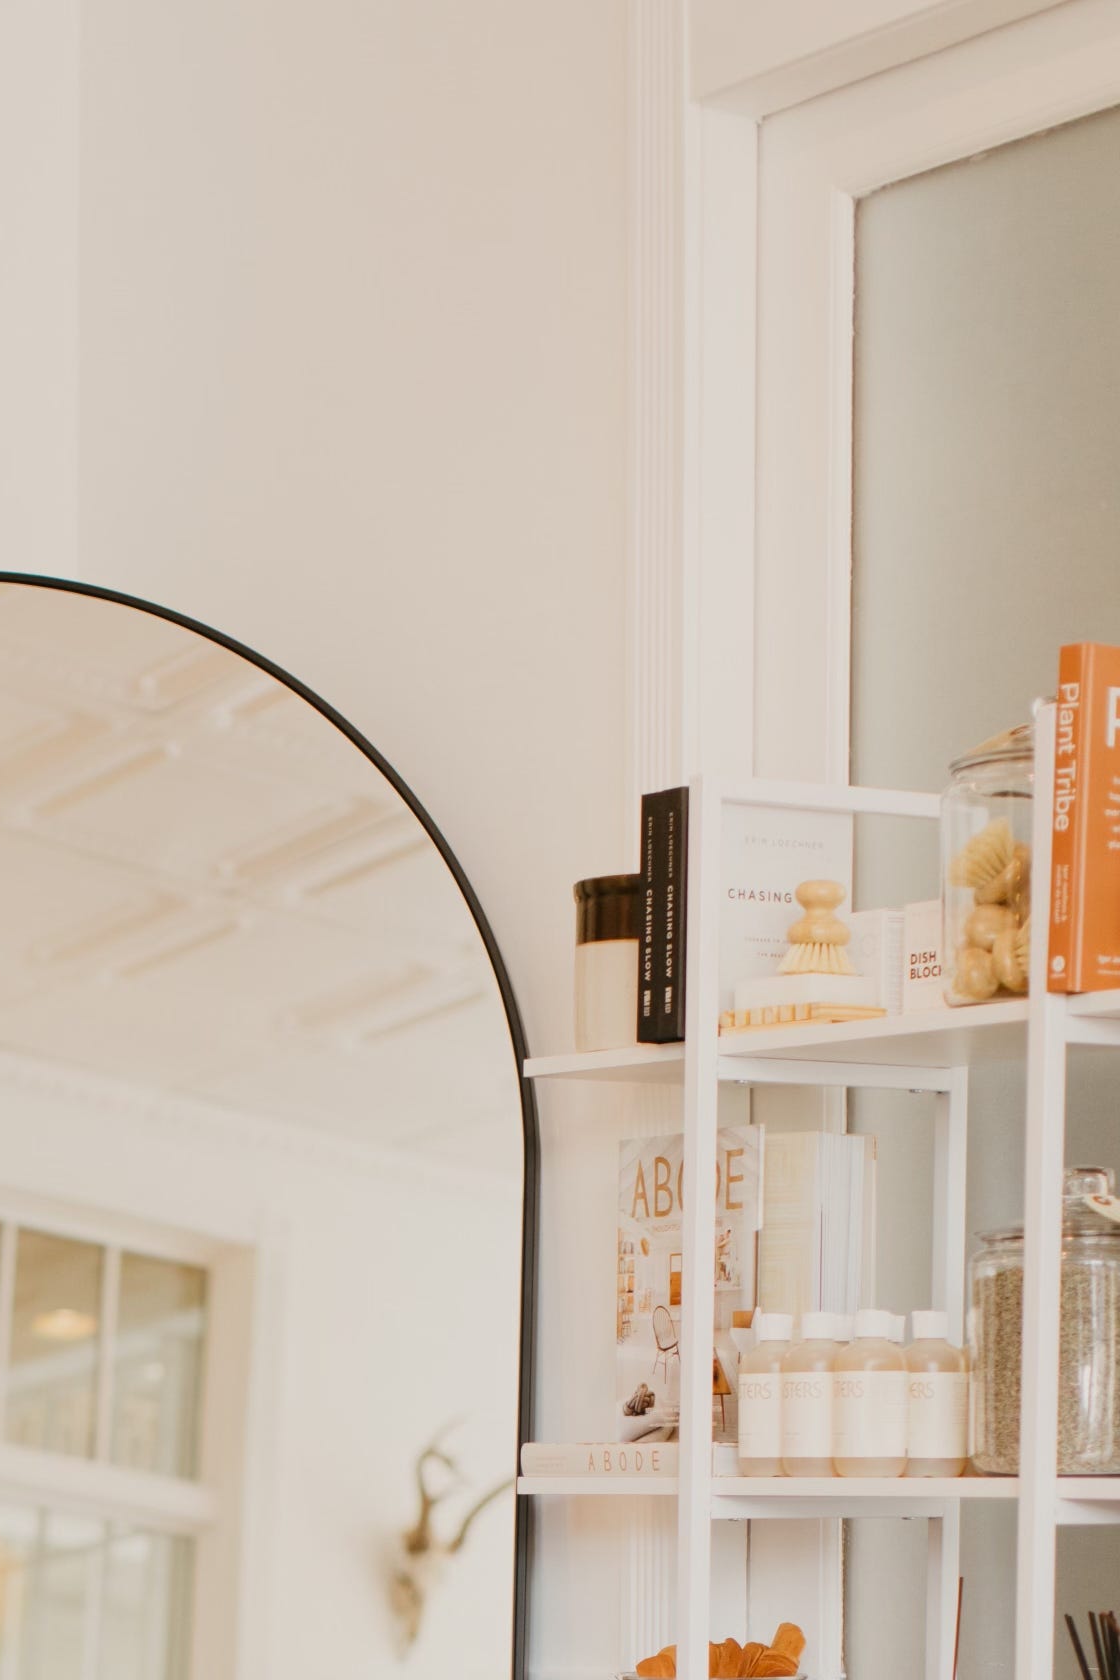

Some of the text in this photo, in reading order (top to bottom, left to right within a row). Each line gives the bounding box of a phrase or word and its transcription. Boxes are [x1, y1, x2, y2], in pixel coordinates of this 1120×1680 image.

[1054, 682, 1080, 832] Plant Tribe
[666, 885, 674, 939] CHASING
[728, 888, 793, 904] CHASING
[645, 889, 653, 943] CHASING
[644, 947, 652, 981] SLOW
[665, 943, 673, 978] SLOW
[910, 950, 937, 966] DISH
[631, 1148, 745, 1218] ABE
[587, 1450, 661, 1472] ABODE
